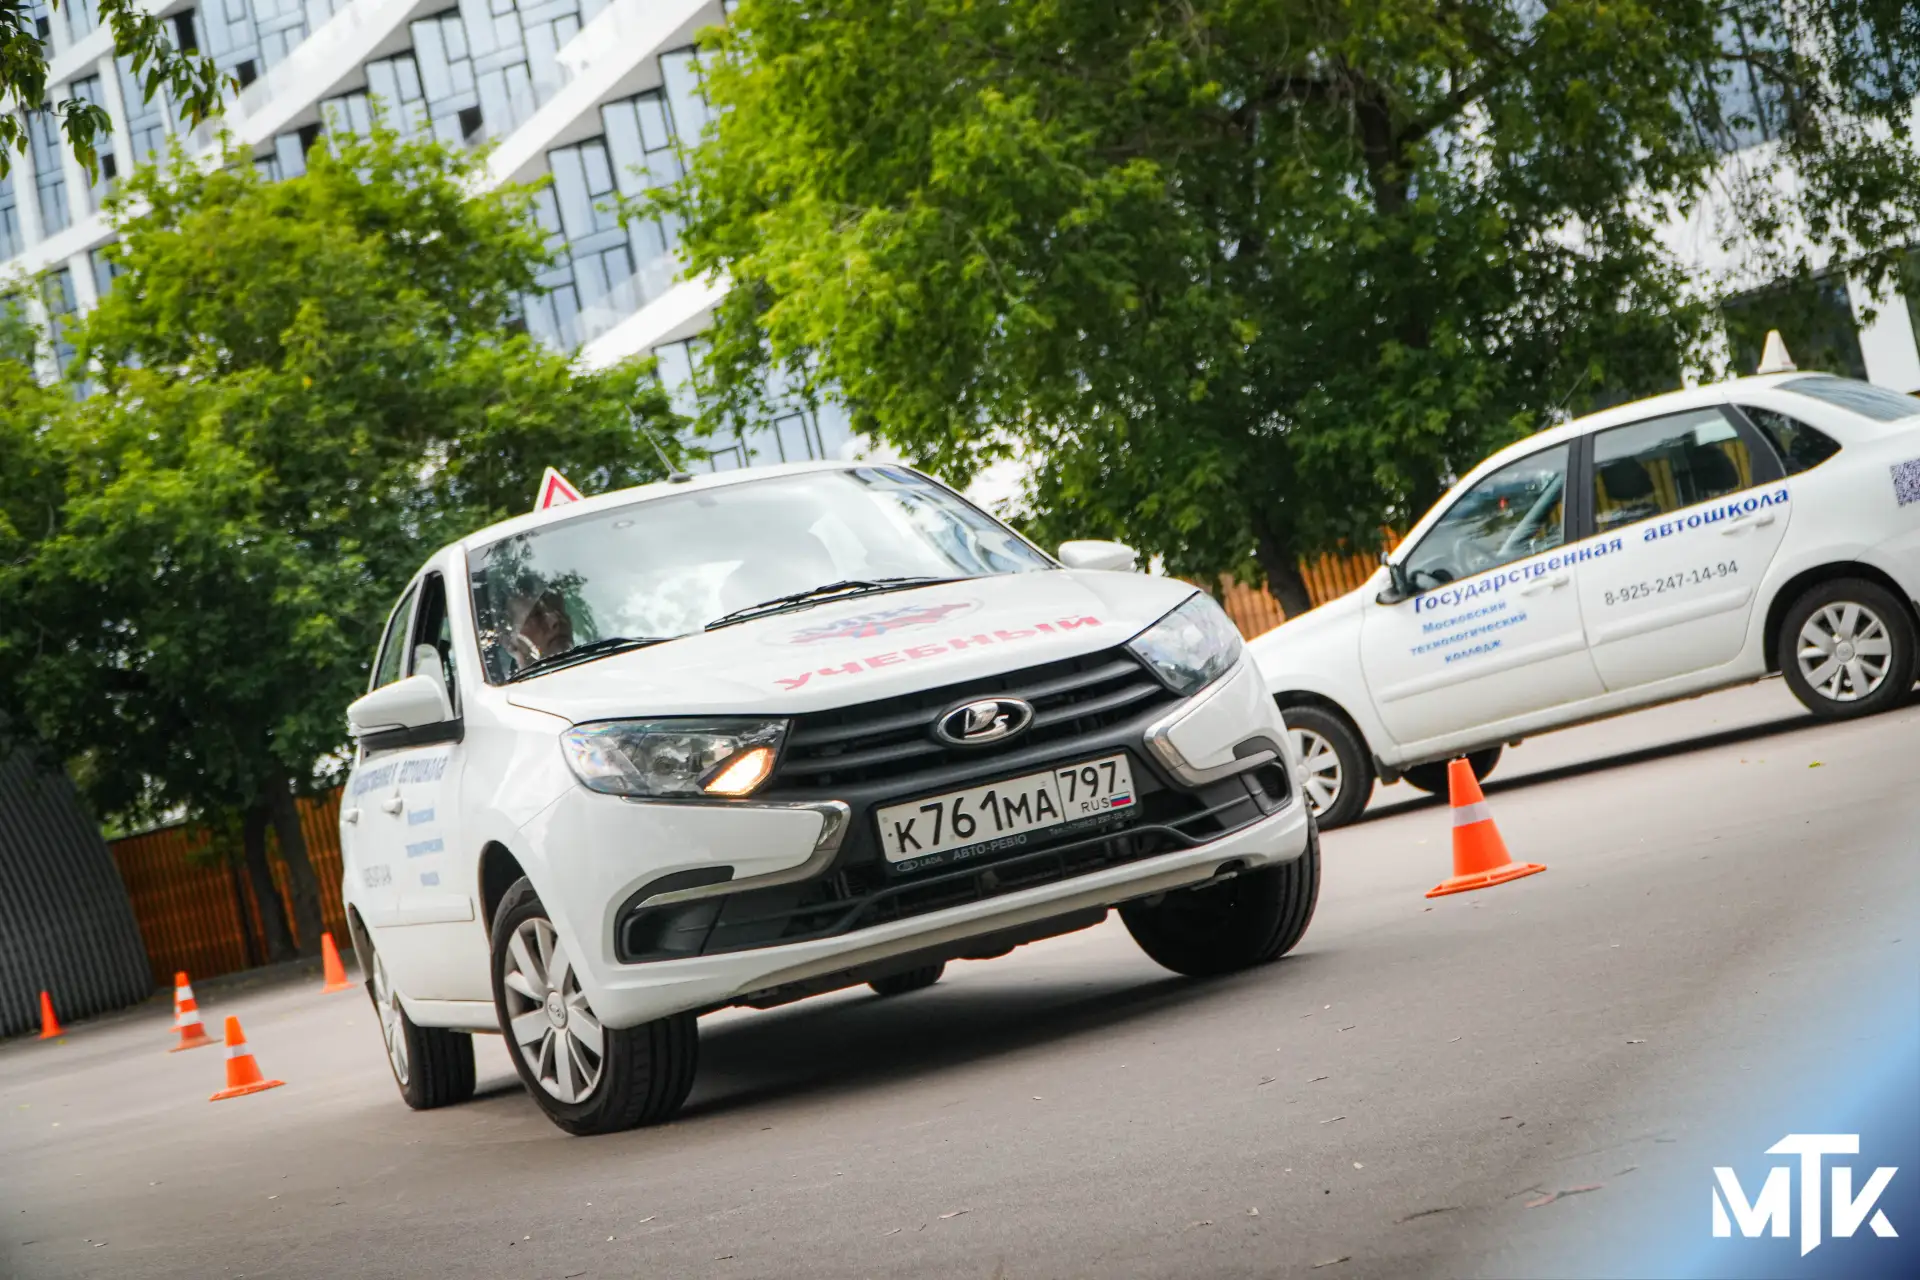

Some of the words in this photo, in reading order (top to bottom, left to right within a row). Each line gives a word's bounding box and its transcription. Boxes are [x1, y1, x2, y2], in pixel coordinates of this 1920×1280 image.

[1414, 537, 1622, 613] Государственная
[1643, 489, 1789, 542] автошкола
[1604, 560, 1738, 605] 8-925-247-14-94
[1410, 610, 1528, 655] технологический
[1422, 600, 1507, 634] Московский
[773, 614, 1104, 692] УЧЕБНЫЙ
[1444, 639, 1502, 663] колледж
[895, 788, 1059, 853] К761МА
[1059, 761, 1117, 803] 797
[1081, 796, 1110, 813] RUS
[953, 834, 1027, 860] АВТО-РЕВЮ
